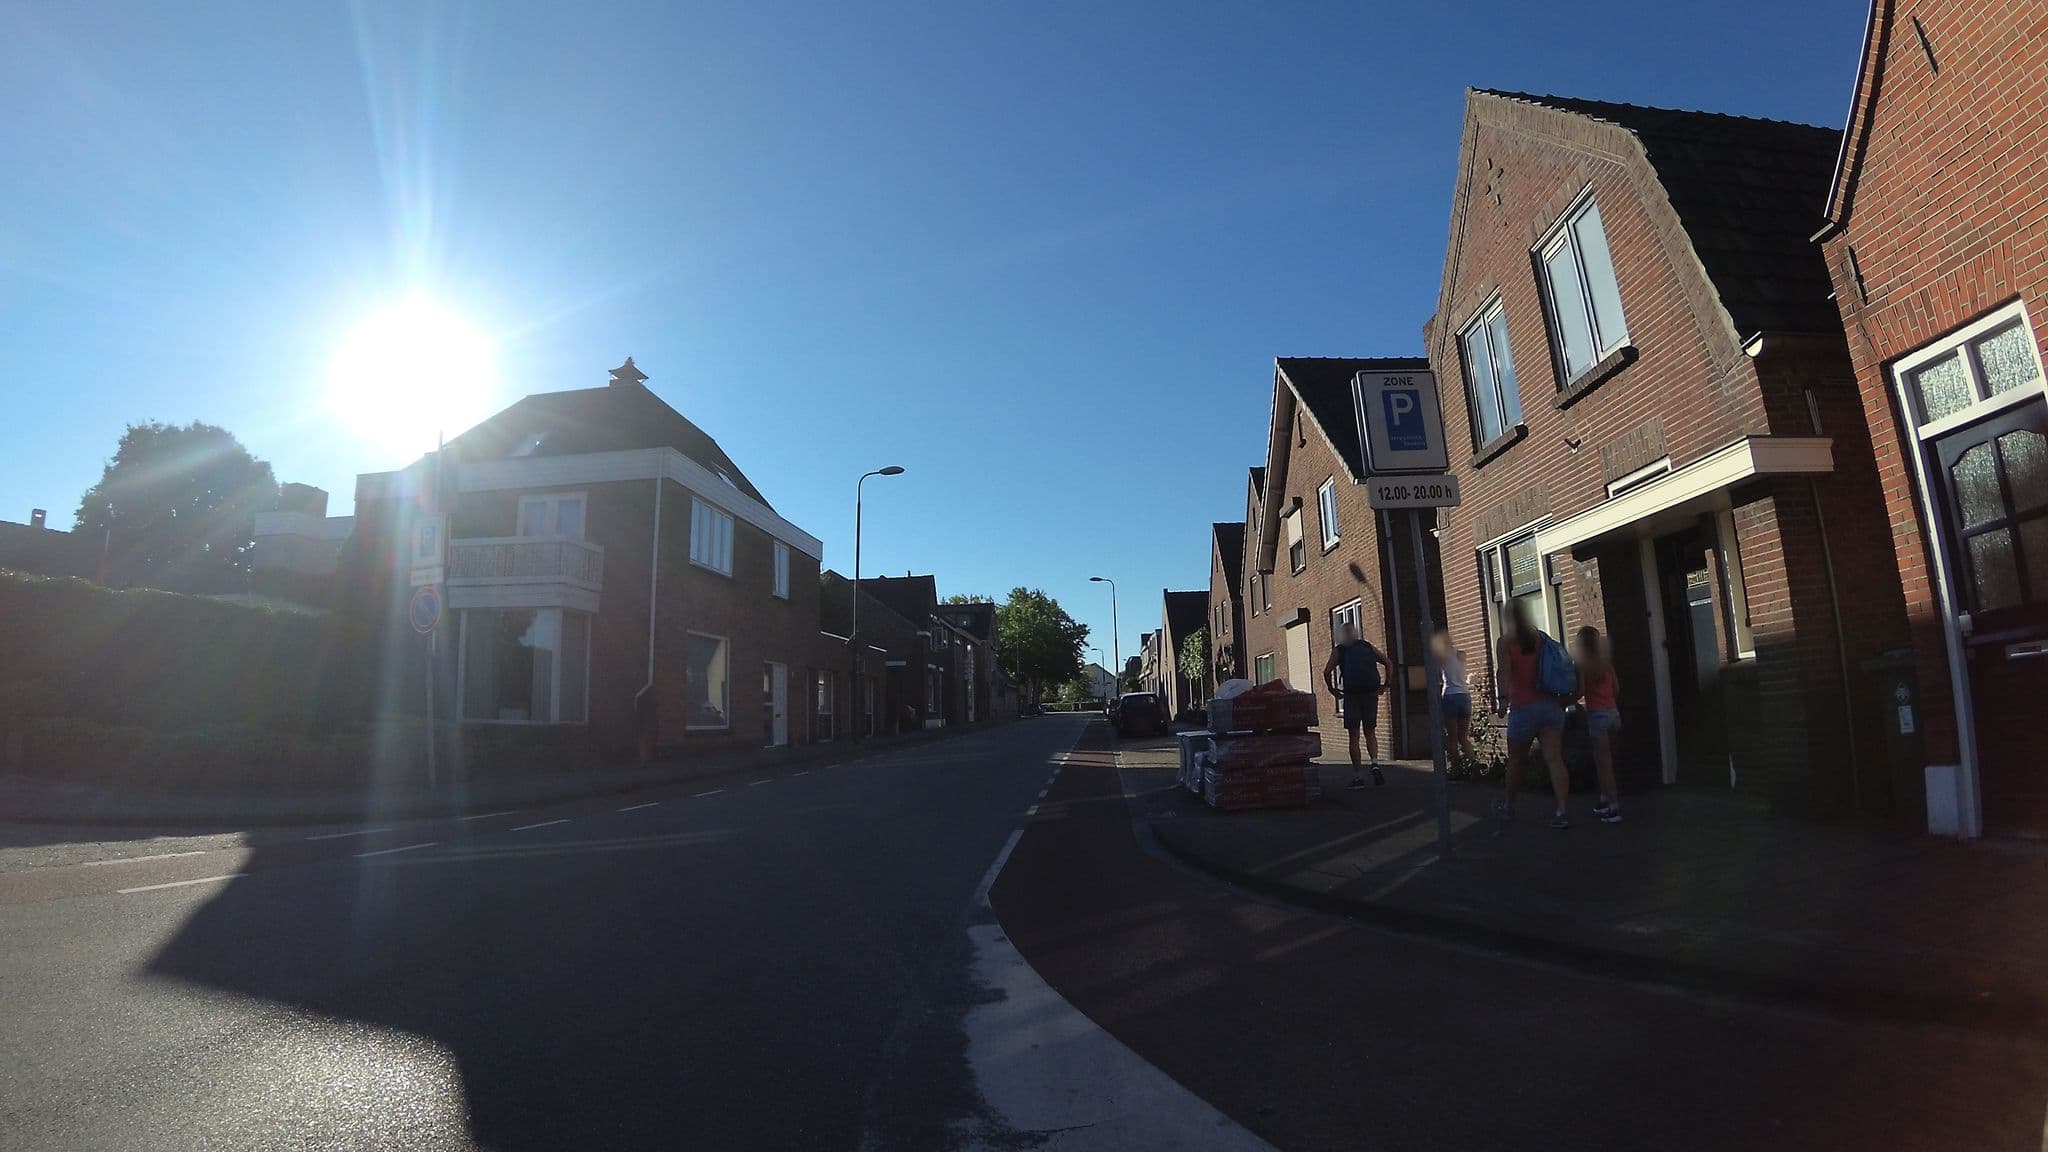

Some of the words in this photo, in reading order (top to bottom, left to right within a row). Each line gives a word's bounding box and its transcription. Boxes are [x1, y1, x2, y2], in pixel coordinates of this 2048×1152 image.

[1383, 376, 1414, 386] ZONE
[1390, 393, 1414, 426] P
[1445, 485, 1452, 498] h
